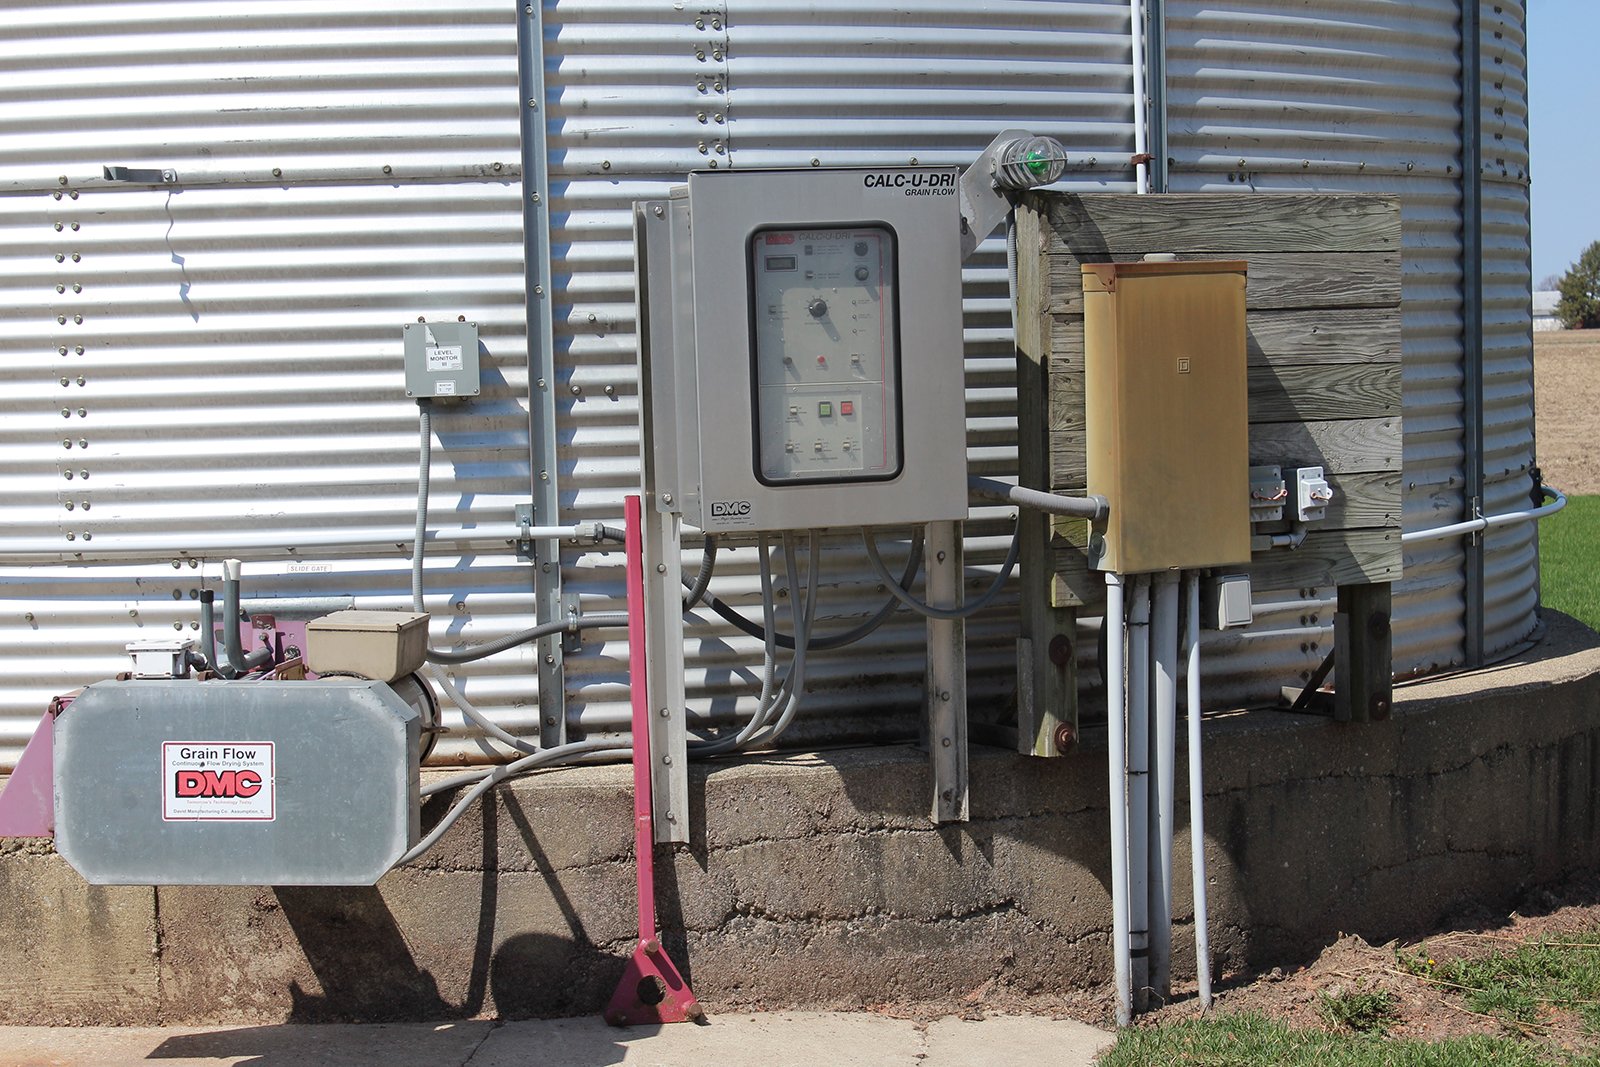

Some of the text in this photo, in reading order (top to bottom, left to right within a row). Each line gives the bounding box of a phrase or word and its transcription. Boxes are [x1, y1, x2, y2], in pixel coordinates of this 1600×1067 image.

[864, 174, 955, 187] CALC-U-DRI
[711, 501, 751, 516] DMC
[180, 748, 256, 759] Grain Flow
[175, 770, 262, 798] DMC
